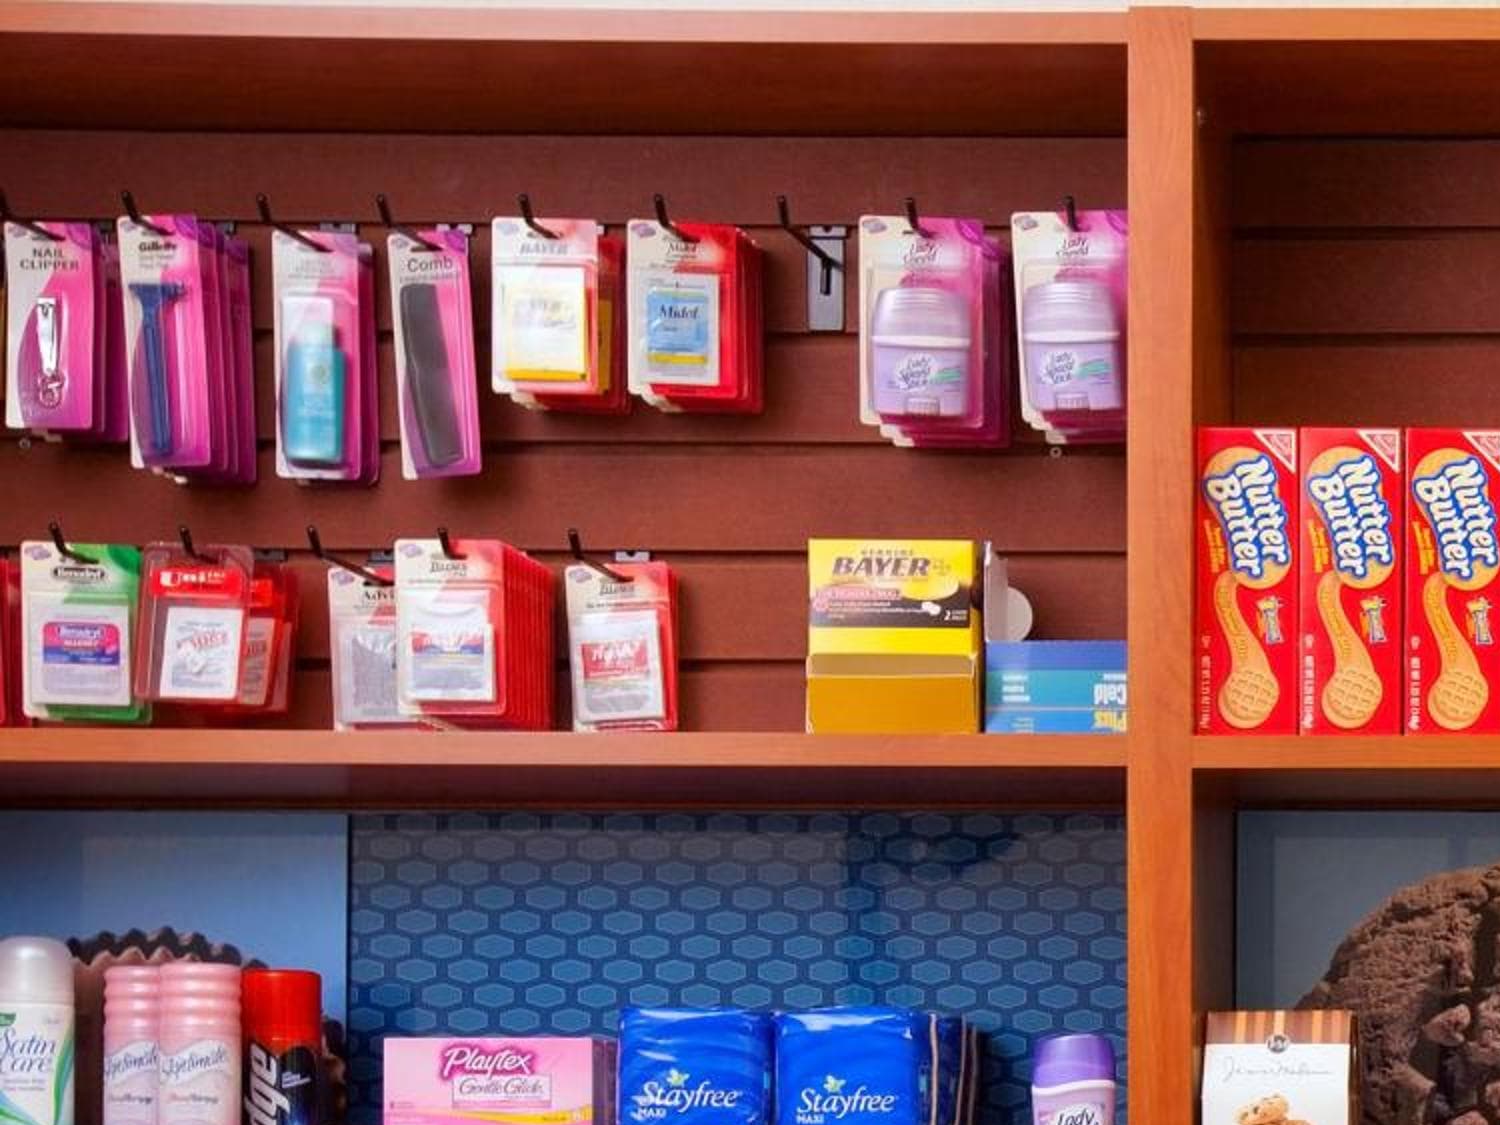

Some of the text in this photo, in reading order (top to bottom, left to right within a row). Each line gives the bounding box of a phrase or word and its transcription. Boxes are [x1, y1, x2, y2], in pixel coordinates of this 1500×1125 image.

[19, 258, 79, 270] CLIPPER
[32, 248, 64, 258] NAIL
[407, 256, 453, 272] Comb
[659, 304, 701, 320] Midol
[1237, 457, 1289, 564] Nutter
[1338, 457, 1392, 564] Nutter
[1443, 457, 1498, 566] Nutter
[1206, 475, 1263, 578] Butter
[1309, 475, 1366, 577] Butter
[1415, 476, 1472, 580] Butter
[832, 556, 930, 577] BAYER
[363, 588, 395, 600] Advi
[1, 1026, 56, 1055] Satin
[443, 1047, 533, 1078] Playtex
[459, 1078, 544, 1097] Gentle Glide
[641, 1080, 739, 1114] Stayfree
[637, 1107, 667, 1119] MAXI
[798, 1087, 896, 1119] Stayfree
[796, 1113, 825, 1125] MAXI
